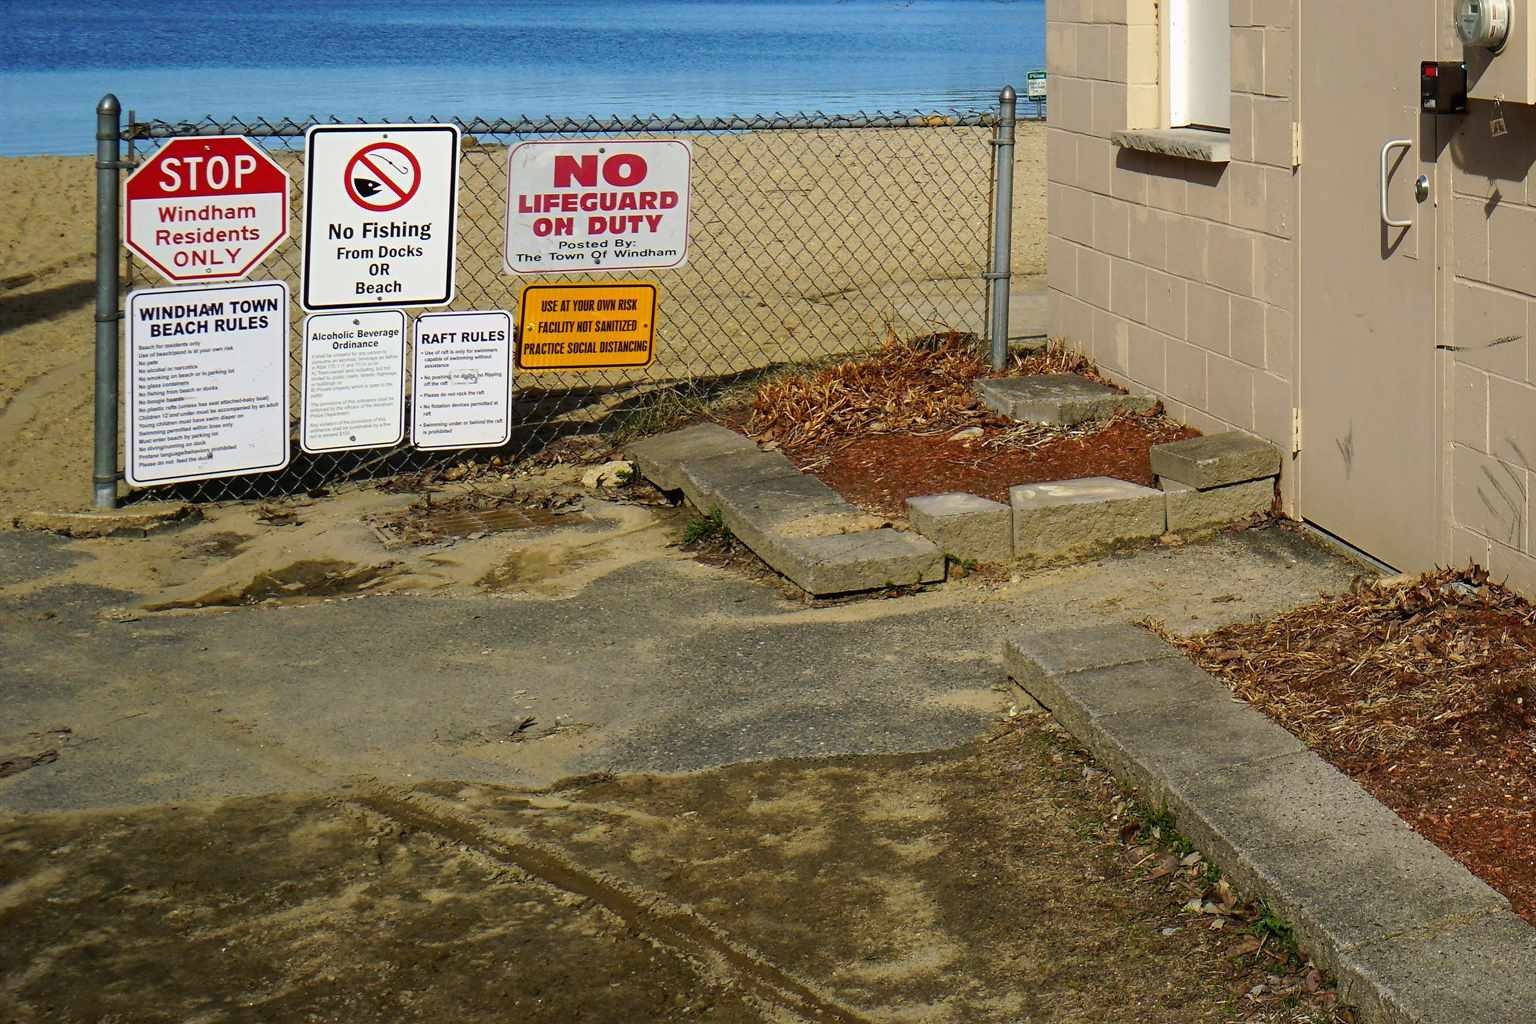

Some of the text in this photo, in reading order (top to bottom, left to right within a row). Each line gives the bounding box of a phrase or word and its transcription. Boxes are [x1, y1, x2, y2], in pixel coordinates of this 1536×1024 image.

[159, 154, 257, 192] STOP
[553, 153, 648, 188] NO
[518, 191, 679, 214] LIFEGUARD
[158, 205, 256, 222] Windham
[328, 222, 432, 240] No Fishing
[532, 214, 664, 238] ON DUTY
[156, 226, 260, 246] Residents
[559, 238, 636, 249] Posted By:
[174, 248, 242, 266] ONLY
[336, 245, 423, 260] From Docks
[516, 248, 677, 262] The Town Of Windham
[368, 263, 390, 276] OR
[356, 280, 402, 294] Beach
[140, 298, 278, 321] WINDHAM TOWN
[541, 298, 638, 312] USE AT YOUR OWN RISK
[150, 316, 269, 338] BEACH RULES
[538, 318, 638, 334] FACILITY NOT SANITIZED
[312, 329, 400, 341] Alcoholic Beverage
[422, 330, 505, 344] RAFT RULES
[332, 340, 379, 350] Ordinance
[524, 340, 648, 356] PRACTICE SOCIAL DISTANCING
